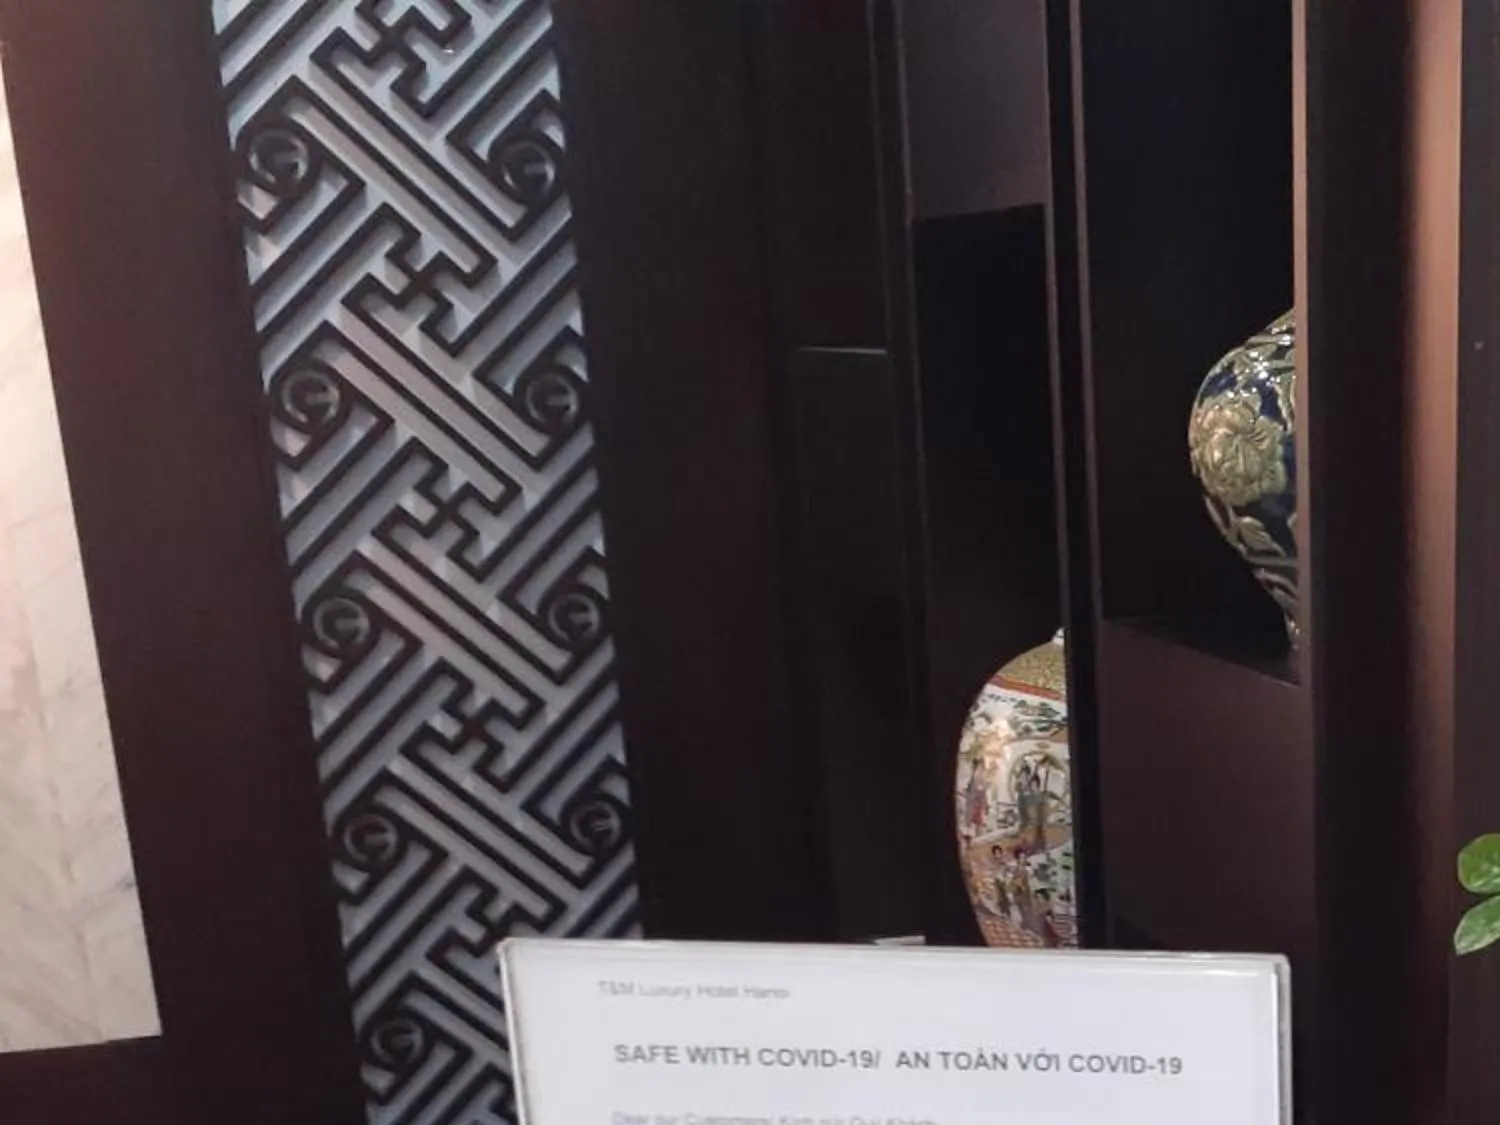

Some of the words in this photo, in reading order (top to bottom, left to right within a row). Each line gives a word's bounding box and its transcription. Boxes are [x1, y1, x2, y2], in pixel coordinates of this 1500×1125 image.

[697, 984, 739, 998] Hotel
[614, 1043, 680, 1065] SAFE
[686, 1045, 751, 1066] WITH
[757, 1047, 881, 1069] COVID-19/
[895, 1051, 930, 1070] AN
[937, 1047, 1009, 1072] TOÀN
[1014, 1047, 1061, 1072] VỚI
[1068, 1054, 1183, 1075] COVID-19
[612, 1112, 648, 1125] Dear
